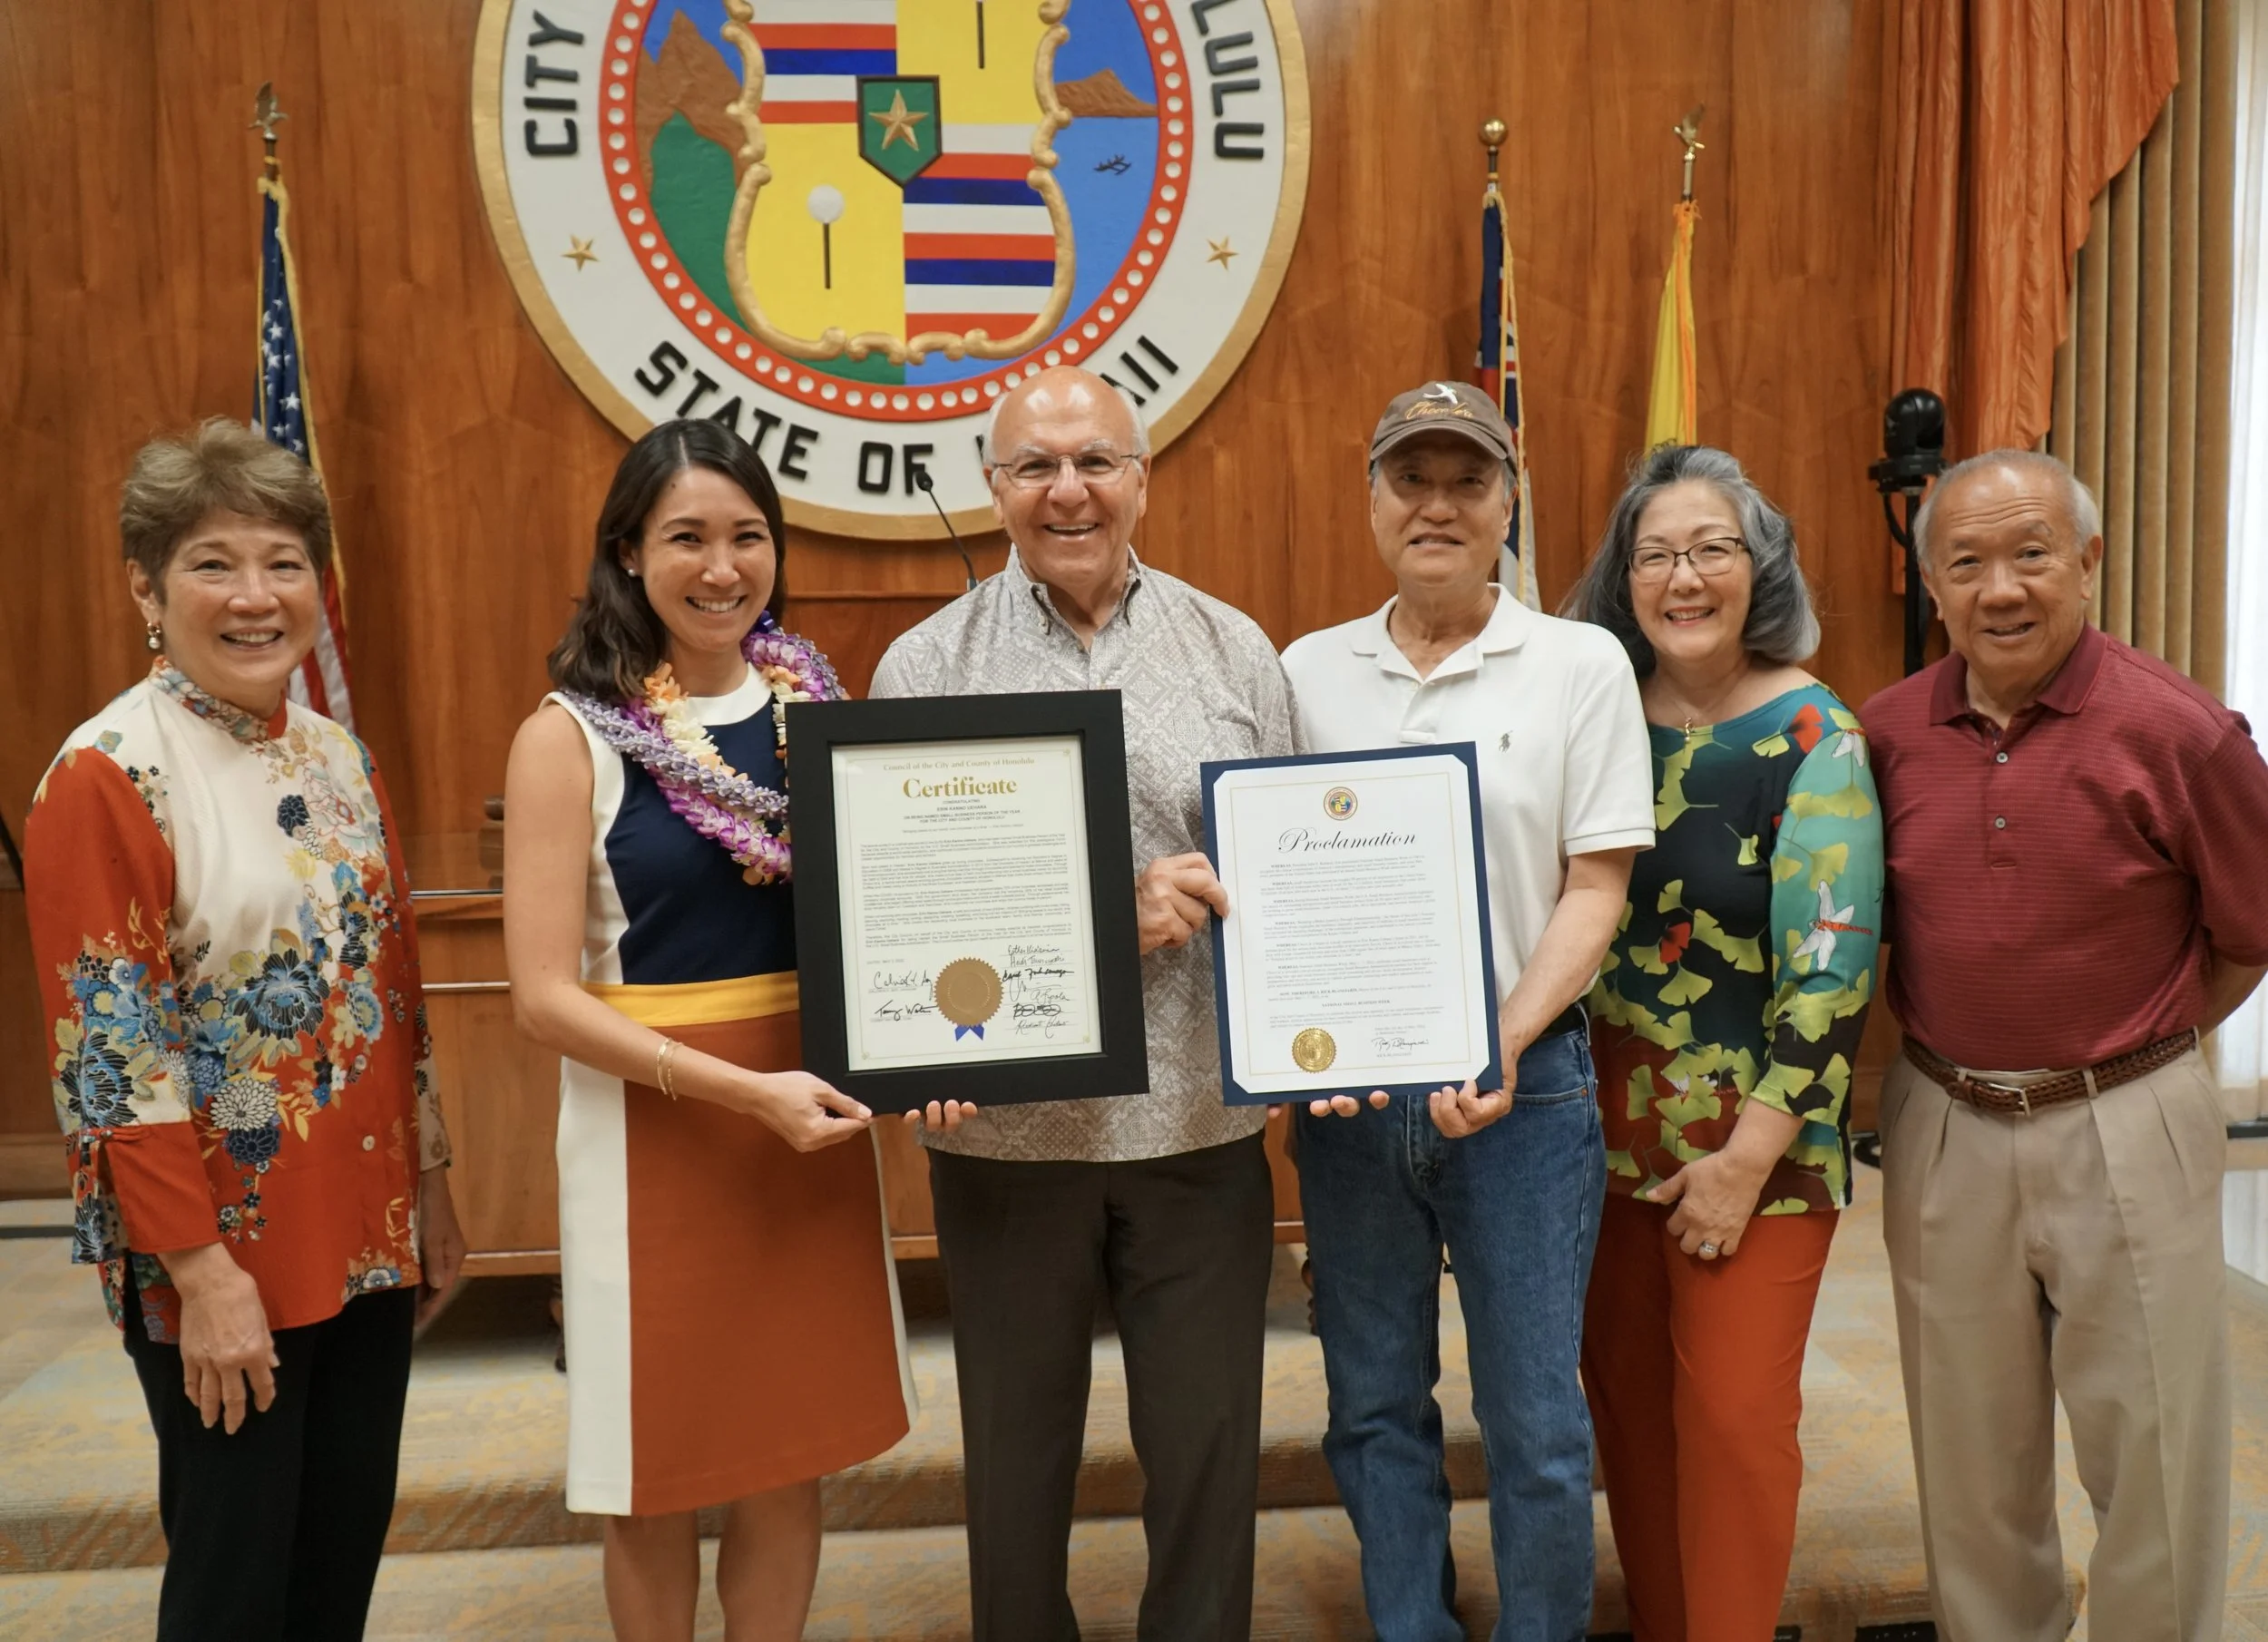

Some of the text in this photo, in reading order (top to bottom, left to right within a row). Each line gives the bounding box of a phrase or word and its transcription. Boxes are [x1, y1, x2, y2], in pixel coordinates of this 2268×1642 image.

[523, 8, 584, 158] CITY
[857, 441, 934, 495] OF
[884, 763, 911, 771] Council
[922, 761, 933, 769] the
[934, 760, 949, 769] City
[966, 759, 991, 768] County
[1002, 757, 1035, 766] Honolulu
[903, 777, 1017, 798] Certificate
[1278, 826, 1415, 854] Proclamation
